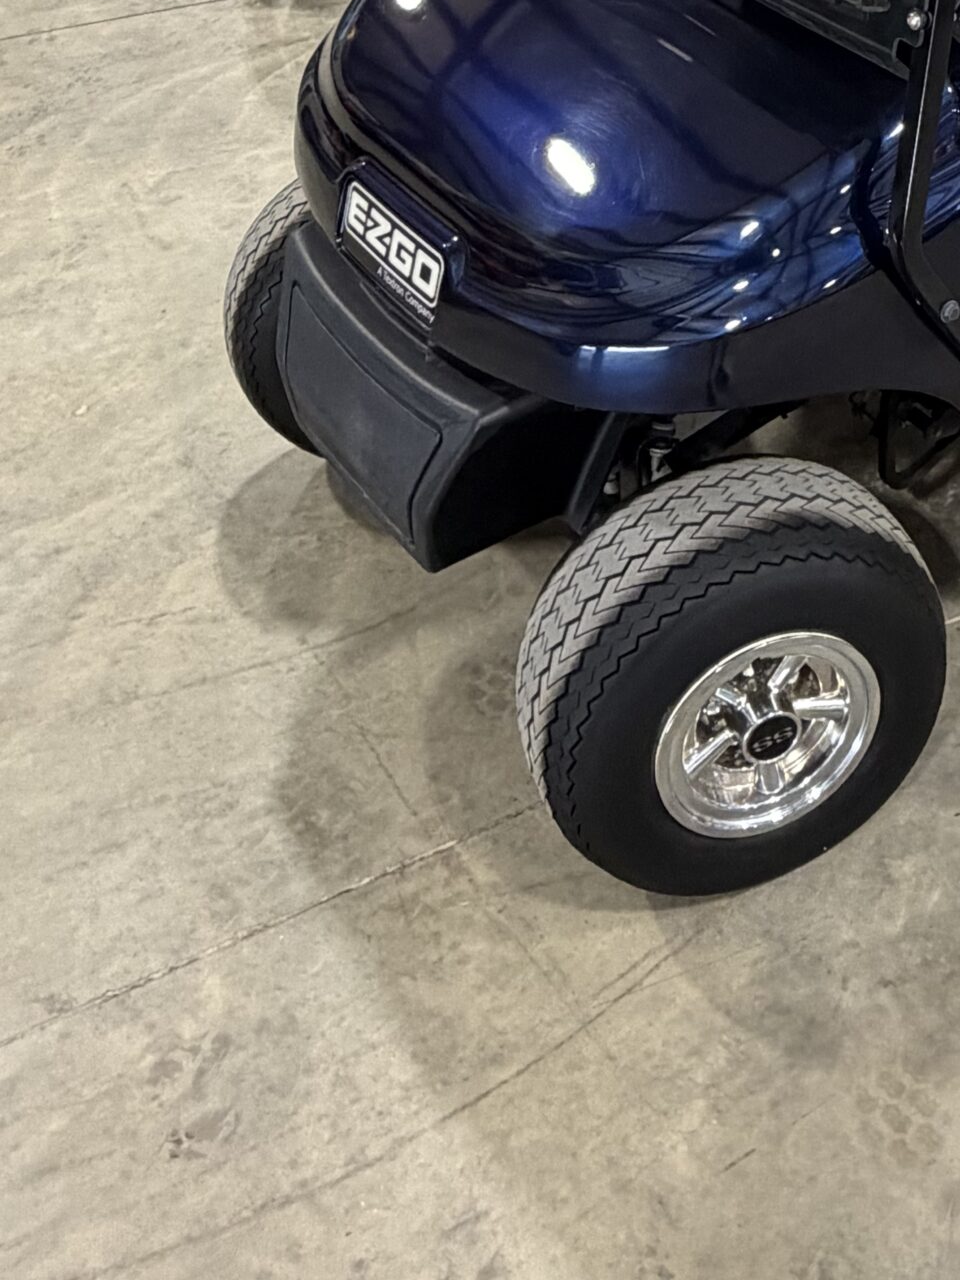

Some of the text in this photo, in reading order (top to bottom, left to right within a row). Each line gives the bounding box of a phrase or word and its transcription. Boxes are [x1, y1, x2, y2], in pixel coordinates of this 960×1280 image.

[376, 266, 435, 324] A Textron Company
[753, 727, 793, 752] SS
